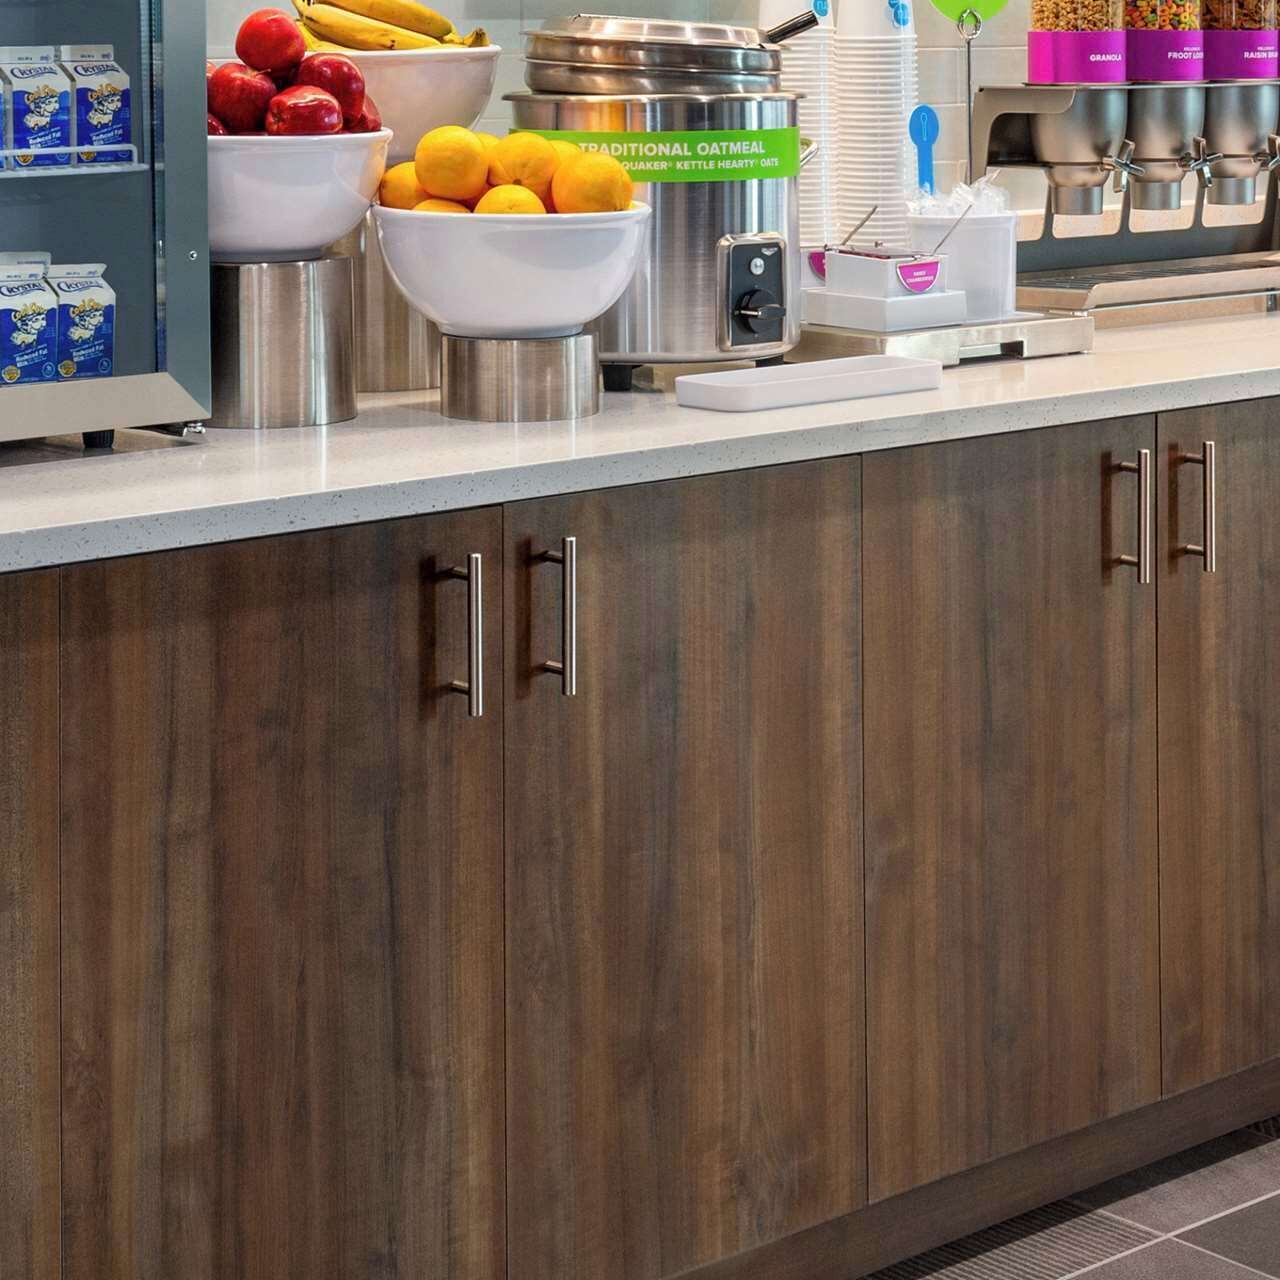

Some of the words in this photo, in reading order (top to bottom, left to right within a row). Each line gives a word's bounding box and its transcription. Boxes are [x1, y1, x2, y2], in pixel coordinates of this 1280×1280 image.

[1089, 53, 1122, 62] GRANOLA
[578, 142, 691, 156] TRADITIONAL
[696, 141, 766, 156] OATMEAL
[676, 160, 715, 170] KETTLE
[57, 280, 103, 293] CRYSTAL
